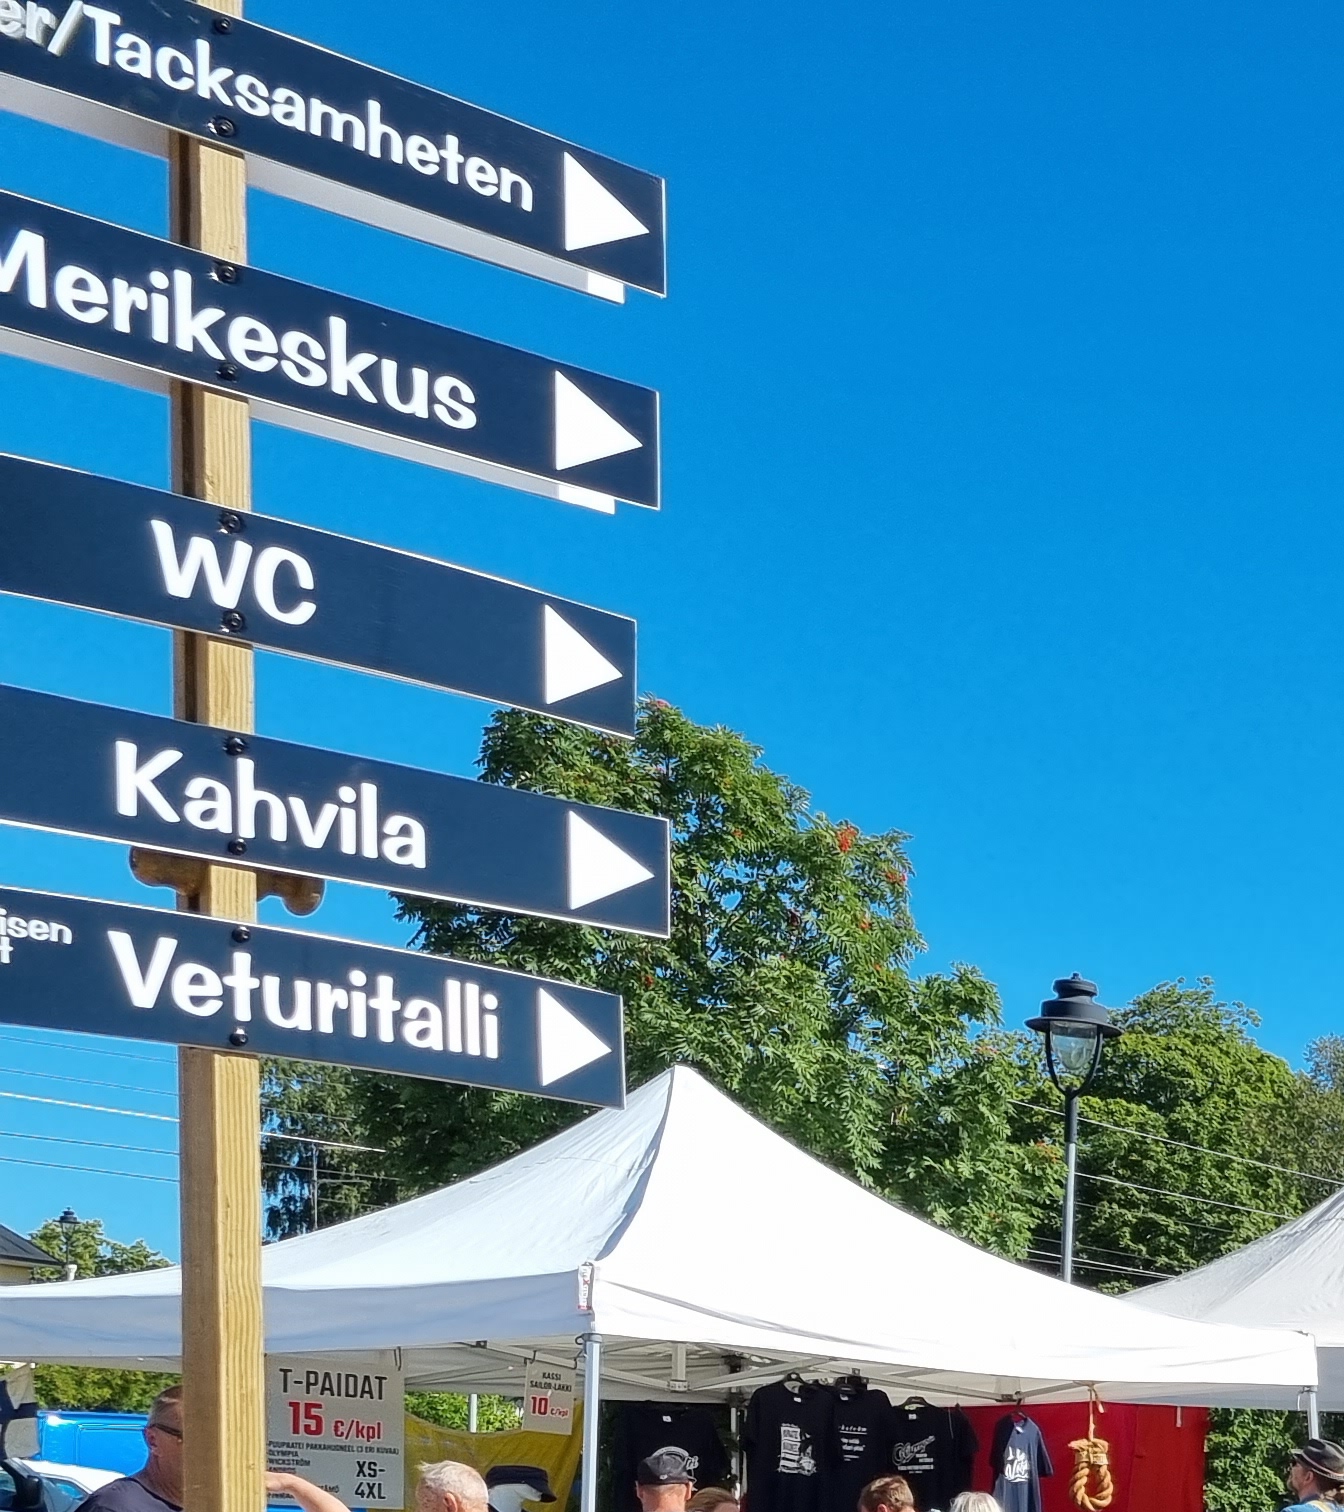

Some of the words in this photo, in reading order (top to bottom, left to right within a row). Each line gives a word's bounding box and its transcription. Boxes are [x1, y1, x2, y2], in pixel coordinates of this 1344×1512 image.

[0, 229, 477, 431] Merikeskus
[150, 519, 317, 626] WC
[114, 740, 427, 869] Kahvila
[107, 930, 499, 1060] Veturitalli
[279, 1368, 388, 1400] T-PAIDAT
[288, 1401, 323, 1436] 15
[333, 1419, 382, 1442] €/kpl
[530, 1396, 549, 1416] 10
[355, 1460, 386, 1478] XS-
[354, 1481, 386, 1500] 4XL
